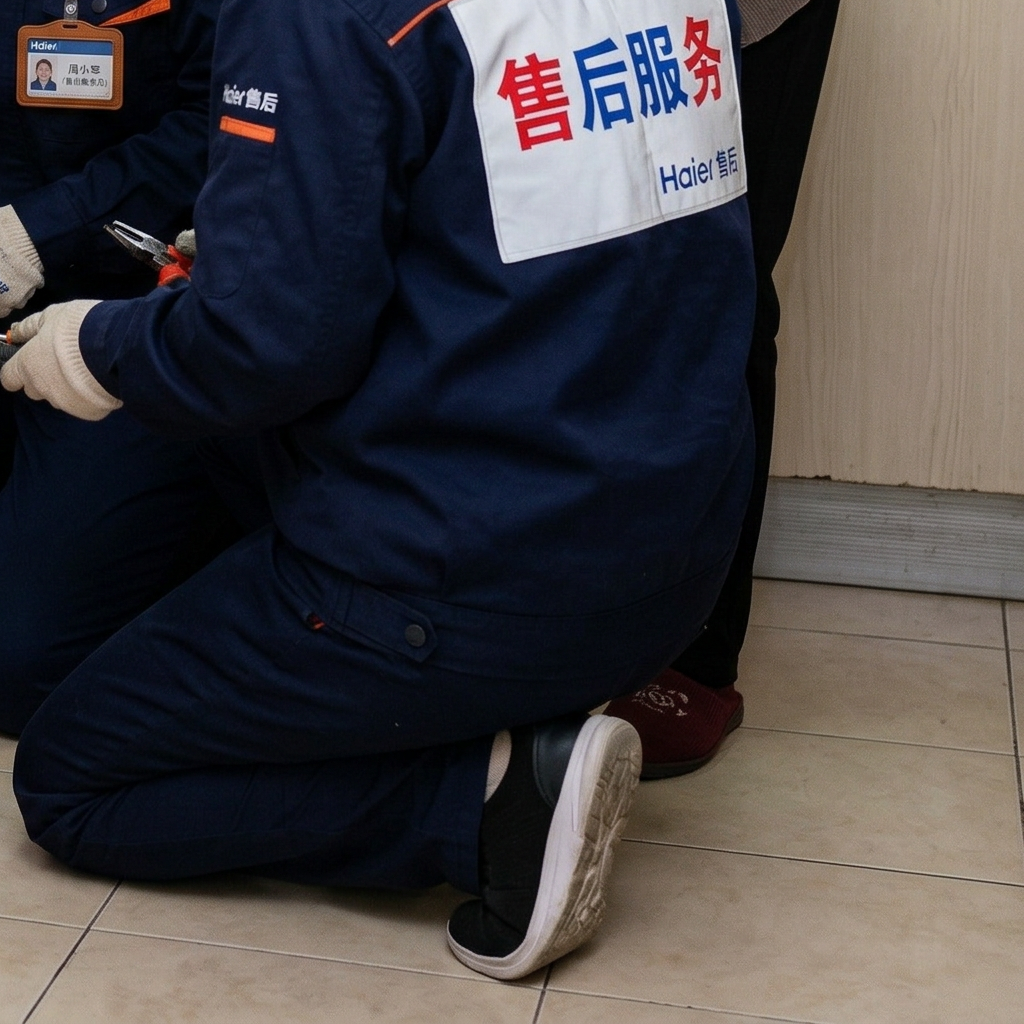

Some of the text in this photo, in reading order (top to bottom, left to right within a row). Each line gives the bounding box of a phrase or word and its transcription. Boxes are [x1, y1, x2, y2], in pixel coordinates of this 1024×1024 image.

[496, 15, 722, 152] 售后服务
[659, 156, 713, 195] Haier
